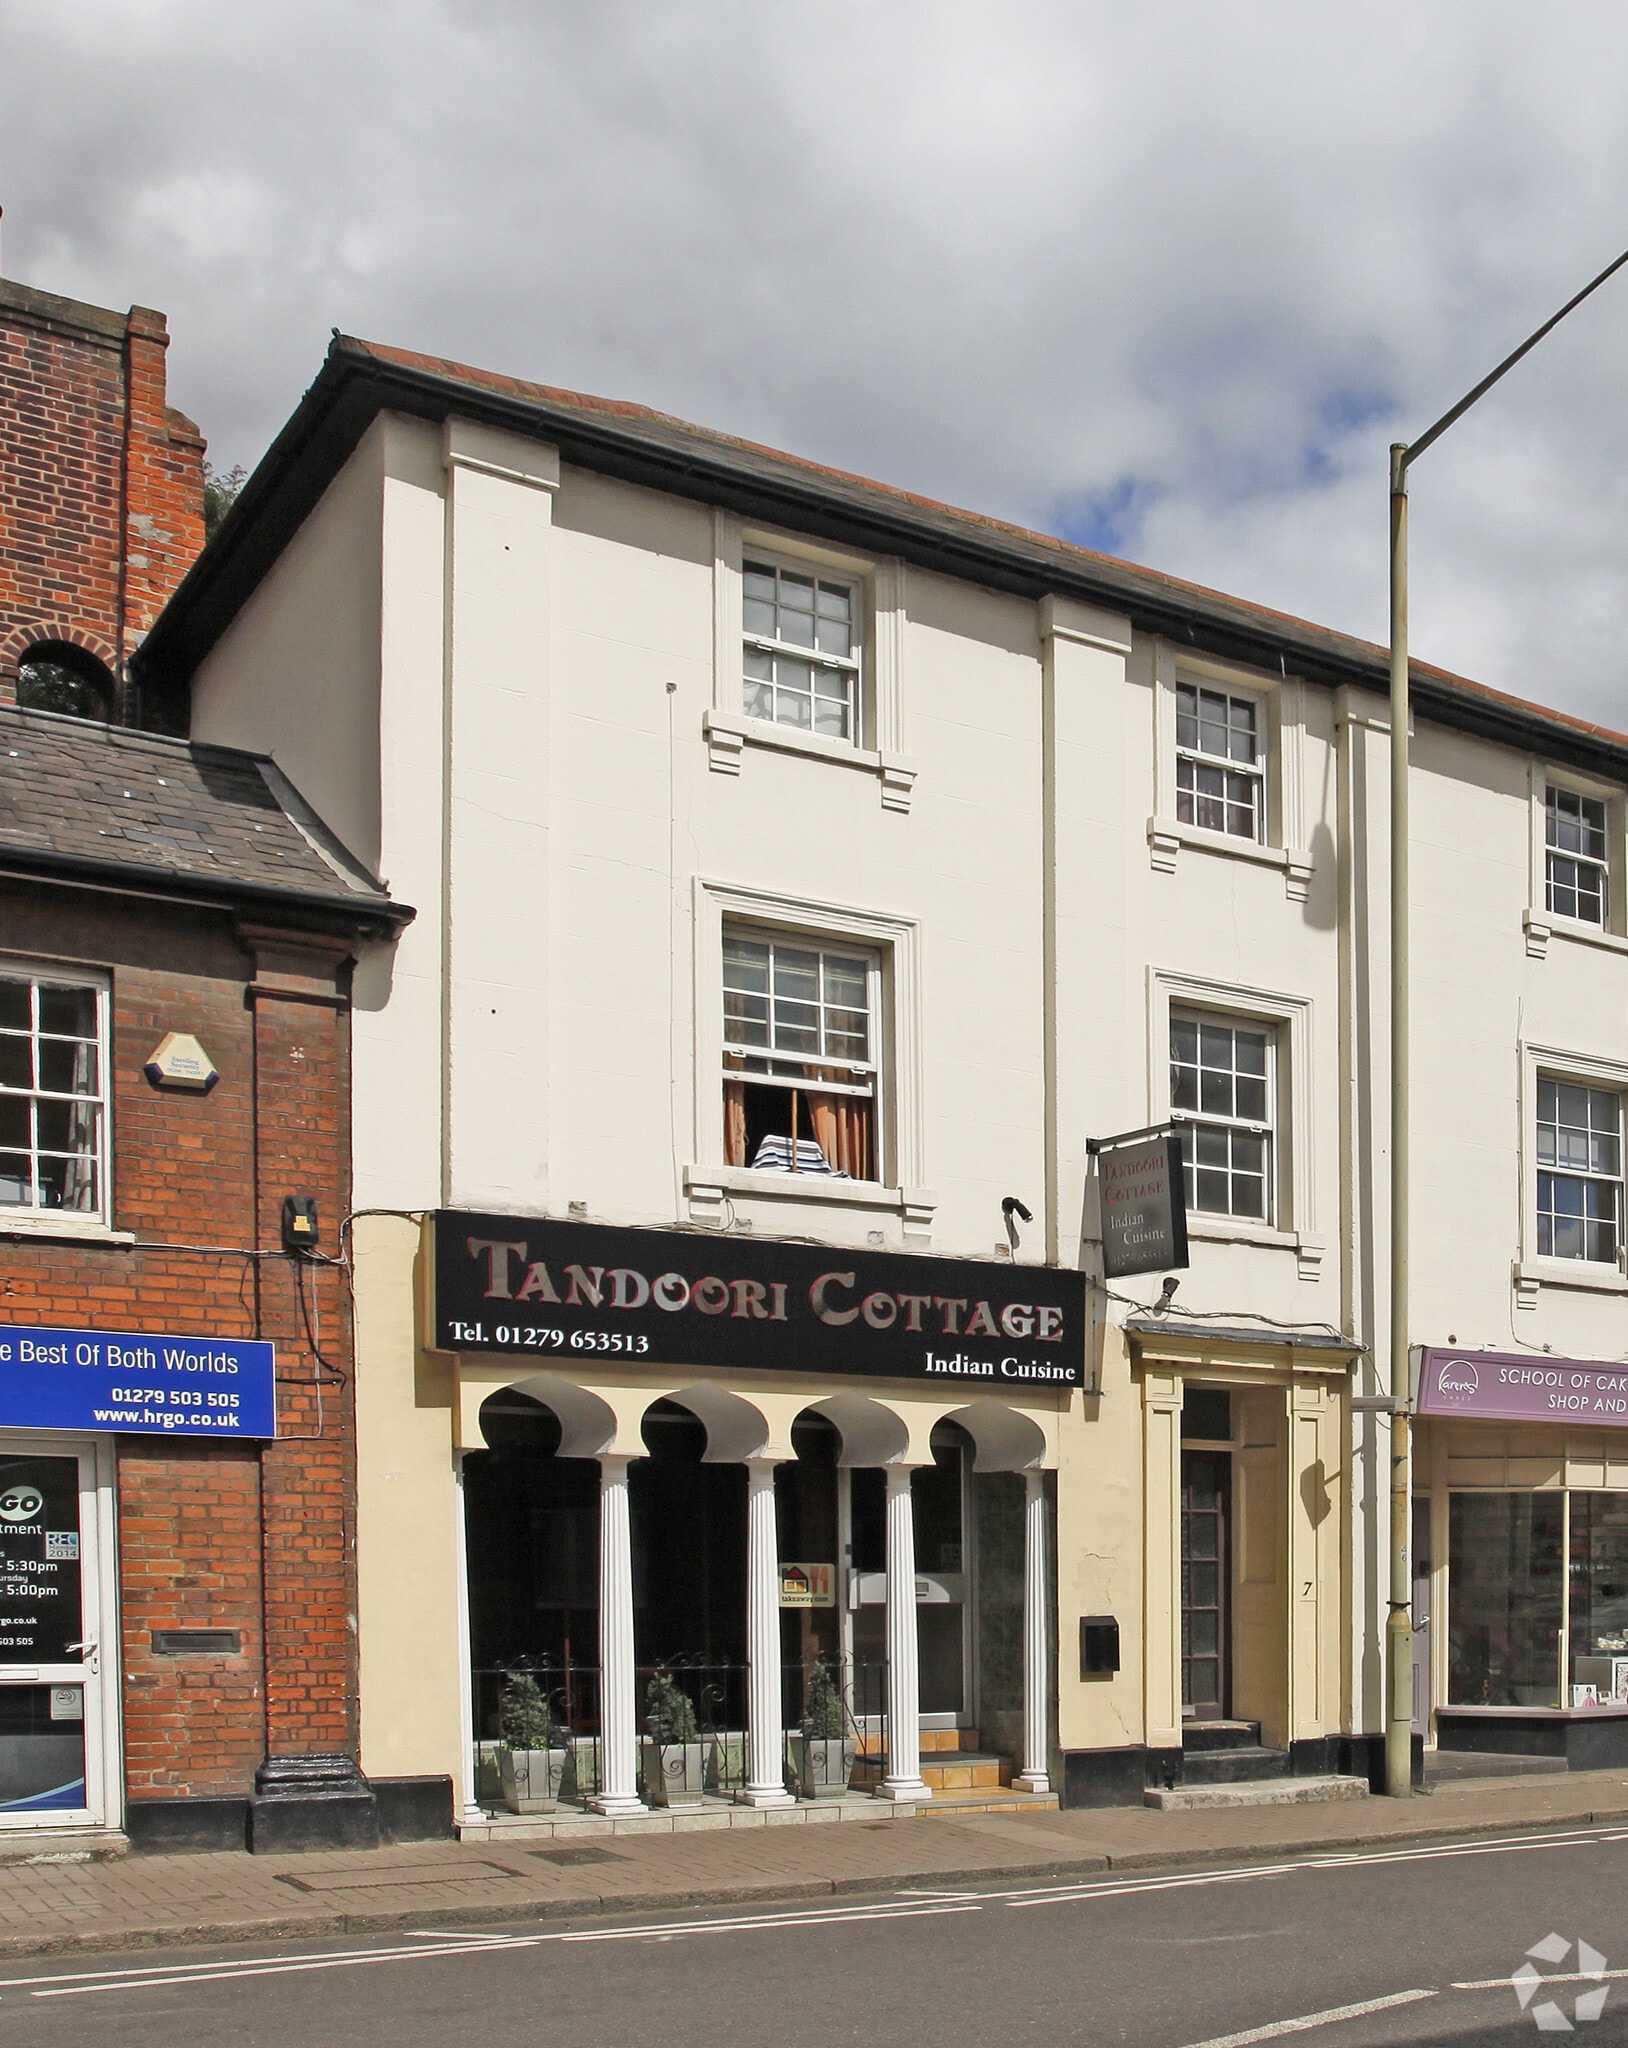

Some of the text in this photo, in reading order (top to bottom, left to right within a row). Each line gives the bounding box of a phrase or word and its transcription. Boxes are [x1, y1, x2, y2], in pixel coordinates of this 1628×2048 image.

[1110, 1212, 1144, 1229] Indian
[1123, 1228, 1165, 1245] Cuisine
[467, 1237, 1064, 1342] TANDOORI COTTAGE
[449, 1321, 649, 1353] Tel. 01279 653513
[19, 1340, 68, 1364] Best
[76, 1343, 100, 1366] Of
[107, 1345, 156, 1369] Both
[163, 1349, 239, 1374] Worlds
[925, 1352, 1076, 1380] Indian Cuisine
[1498, 1368, 1564, 1388] SCHOOL
[1571, 1374, 1591, 1388] OF
[111, 1387, 240, 1408] 01279 503 505
[1548, 1394, 1627, 1413] SHOP AND
[93, 1408, 240, 1428] www.hrgo.co.uk
[6, 1560, 58, 1574] 5:30pm
[6, 1584, 58, 1598] 5:00pm
[1301, 1581, 1313, 1596] 7
[16, 1637, 34, 1645] 505
